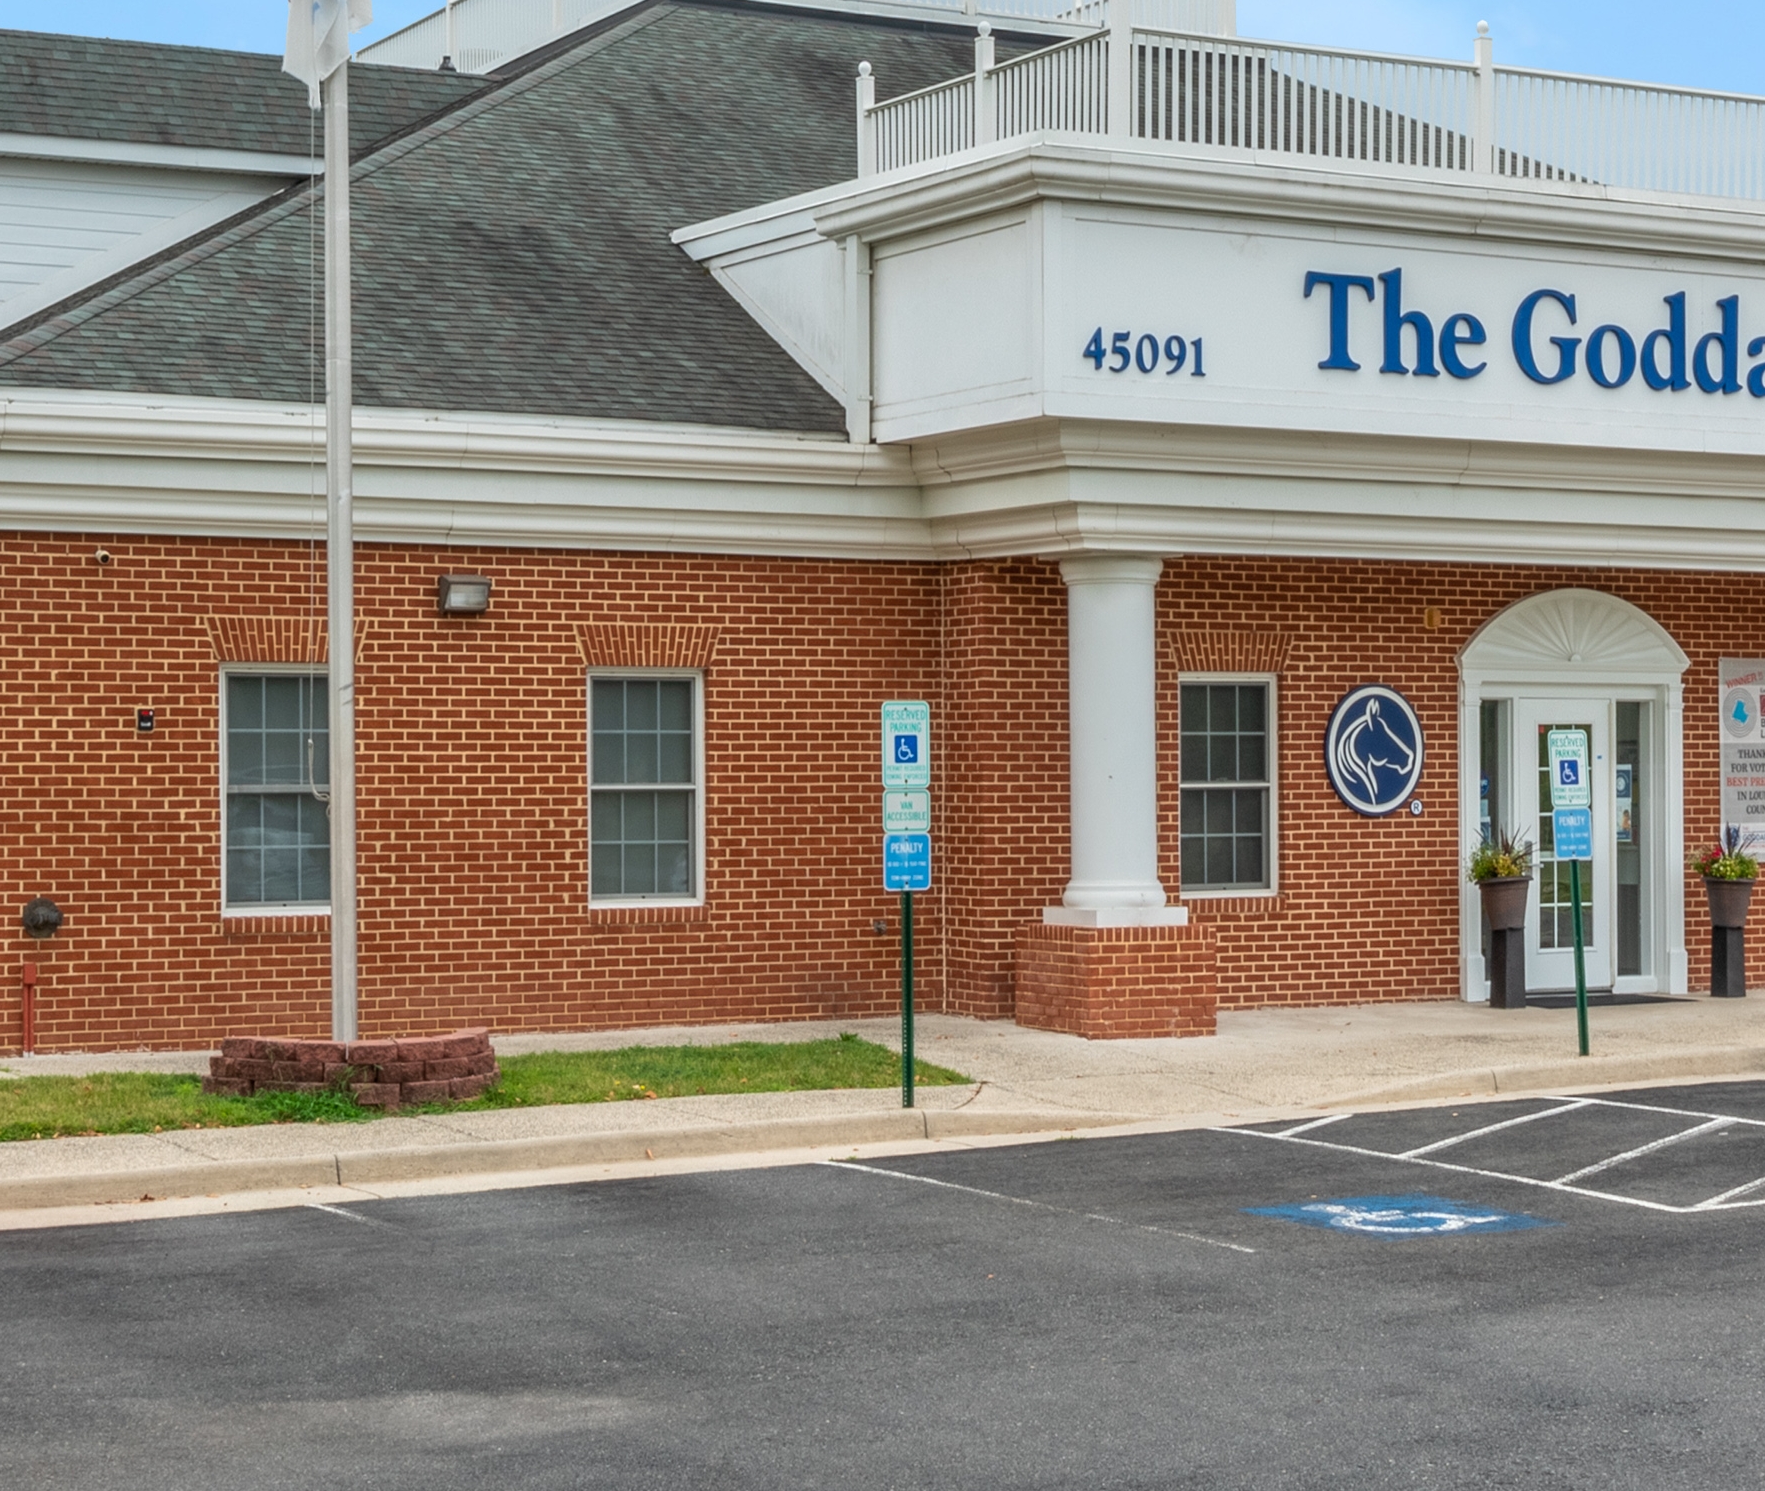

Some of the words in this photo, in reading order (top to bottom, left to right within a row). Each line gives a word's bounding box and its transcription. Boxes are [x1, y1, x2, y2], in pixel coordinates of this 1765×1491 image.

[1303, 267, 1488, 379] The
[1083, 326, 1207, 377] 45091
[1726, 672, 1757, 688] WINNER
[885, 710, 926, 721] RESERVED
[890, 722, 922, 732] PARKING
[1550, 738, 1584, 747] RESERVED
[1555, 749, 1581, 758] PARKING
[1731, 763, 1748, 773] FOR
[1726, 777, 1748, 787] BEST
[1737, 791, 1747, 801] IN
[900, 801, 913, 809] VAN
[887, 812, 926, 821] ACCESSIBLE
[1558, 816, 1585, 826] PENALTY
[890, 842, 924, 854] PENALTY
